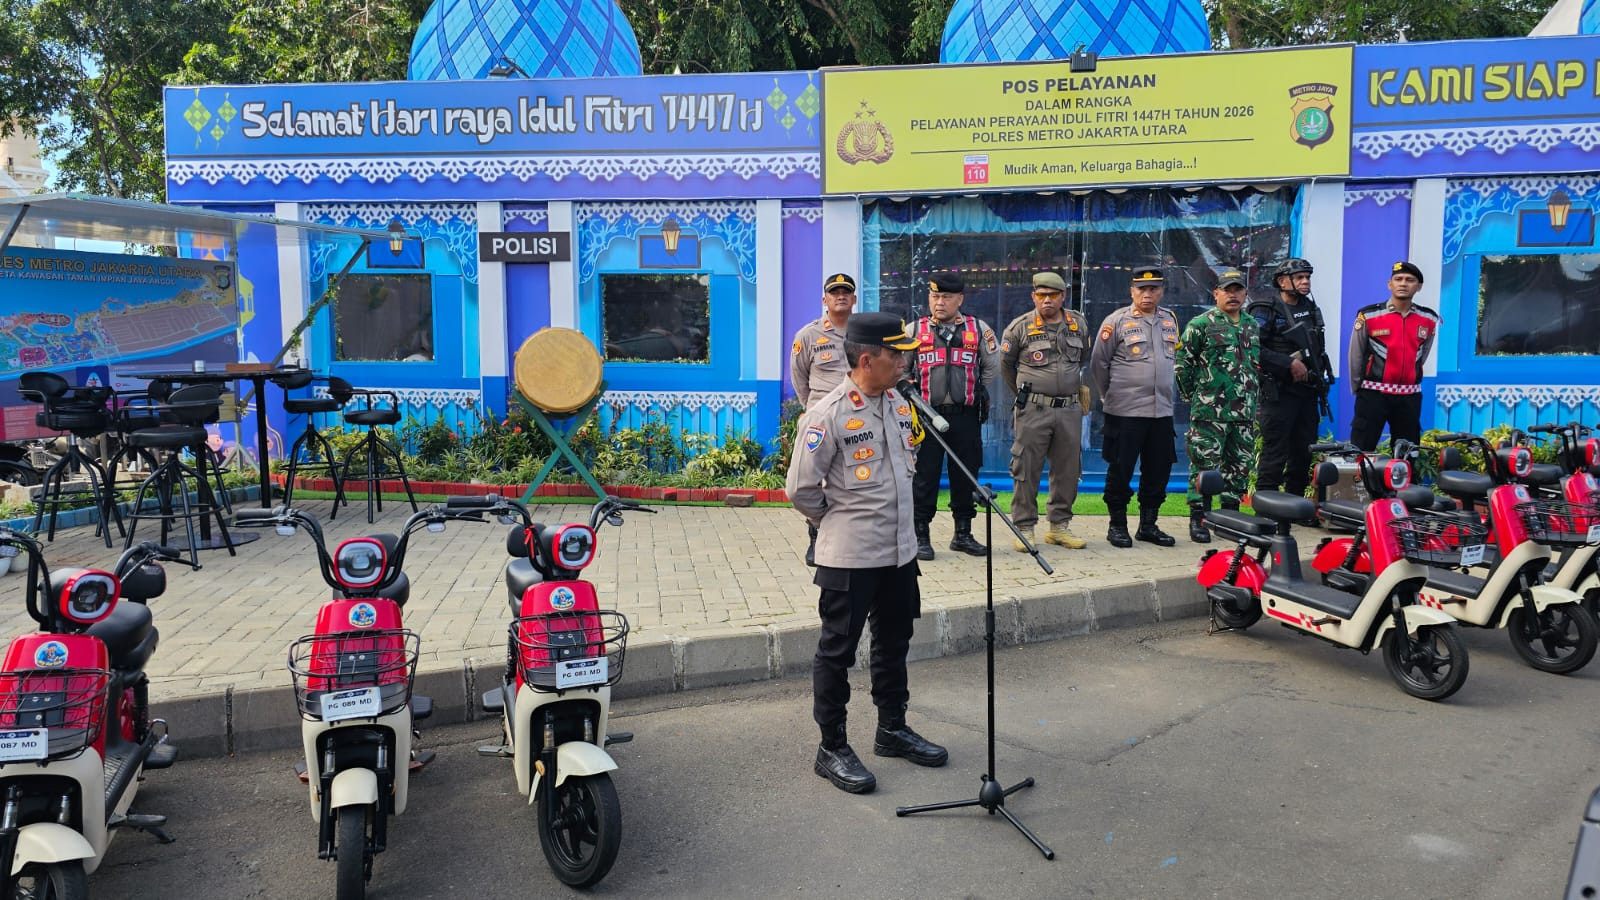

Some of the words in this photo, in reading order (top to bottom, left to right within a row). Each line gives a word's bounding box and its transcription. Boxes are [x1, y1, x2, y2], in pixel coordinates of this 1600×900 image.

[1002, 79, 1039, 94] POS
[1045, 74, 1156, 92] PELAYANAN
[1369, 64, 1475, 107] KAMI
[1484, 59, 1587, 102] SIAP
[1025, 98, 1071, 111] DALAM
[1075, 96, 1132, 109] RANGKA
[242, 101, 366, 137] Selamat
[370, 99, 438, 136] Hari
[444, 108, 513, 144] raya
[518, 96, 578, 134] Idul
[584, 95, 653, 133] Fitri
[661, 94, 736, 132] 1447
[738, 99, 763, 132] H
[910, 117, 986, 130] PELAYANAN
[990, 114, 1058, 127] PERAYAAN
[1062, 112, 1092, 125] IDUL
[1096, 111, 1128, 123] FITRI
[1133, 109, 1170, 121] 1447H
[1174, 107, 1220, 120] TAHUN
[1224, 105, 1254, 118] 2026
[972, 130, 1024, 143] POLRES
[1028, 128, 1073, 141] METRO
[1077, 126, 1139, 139] JAKARTA
[1142, 124, 1187, 137] UTARA
[968, 169, 986, 180] 110
[1004, 163, 1037, 175] Mudik
[1041, 162, 1077, 175] Aman,
[1081, 160, 1132, 173] Keluarga
[1135, 157, 1197, 172] Bahagia...!
[492, 238, 557, 255] POLISI
[0, 255, 24, 269] ES
[30, 258, 85, 272] METRO
[90, 261, 155, 276] JAKARTA
[159, 265, 203, 278] UTARA
[844, 430, 874, 446] WIDODO
